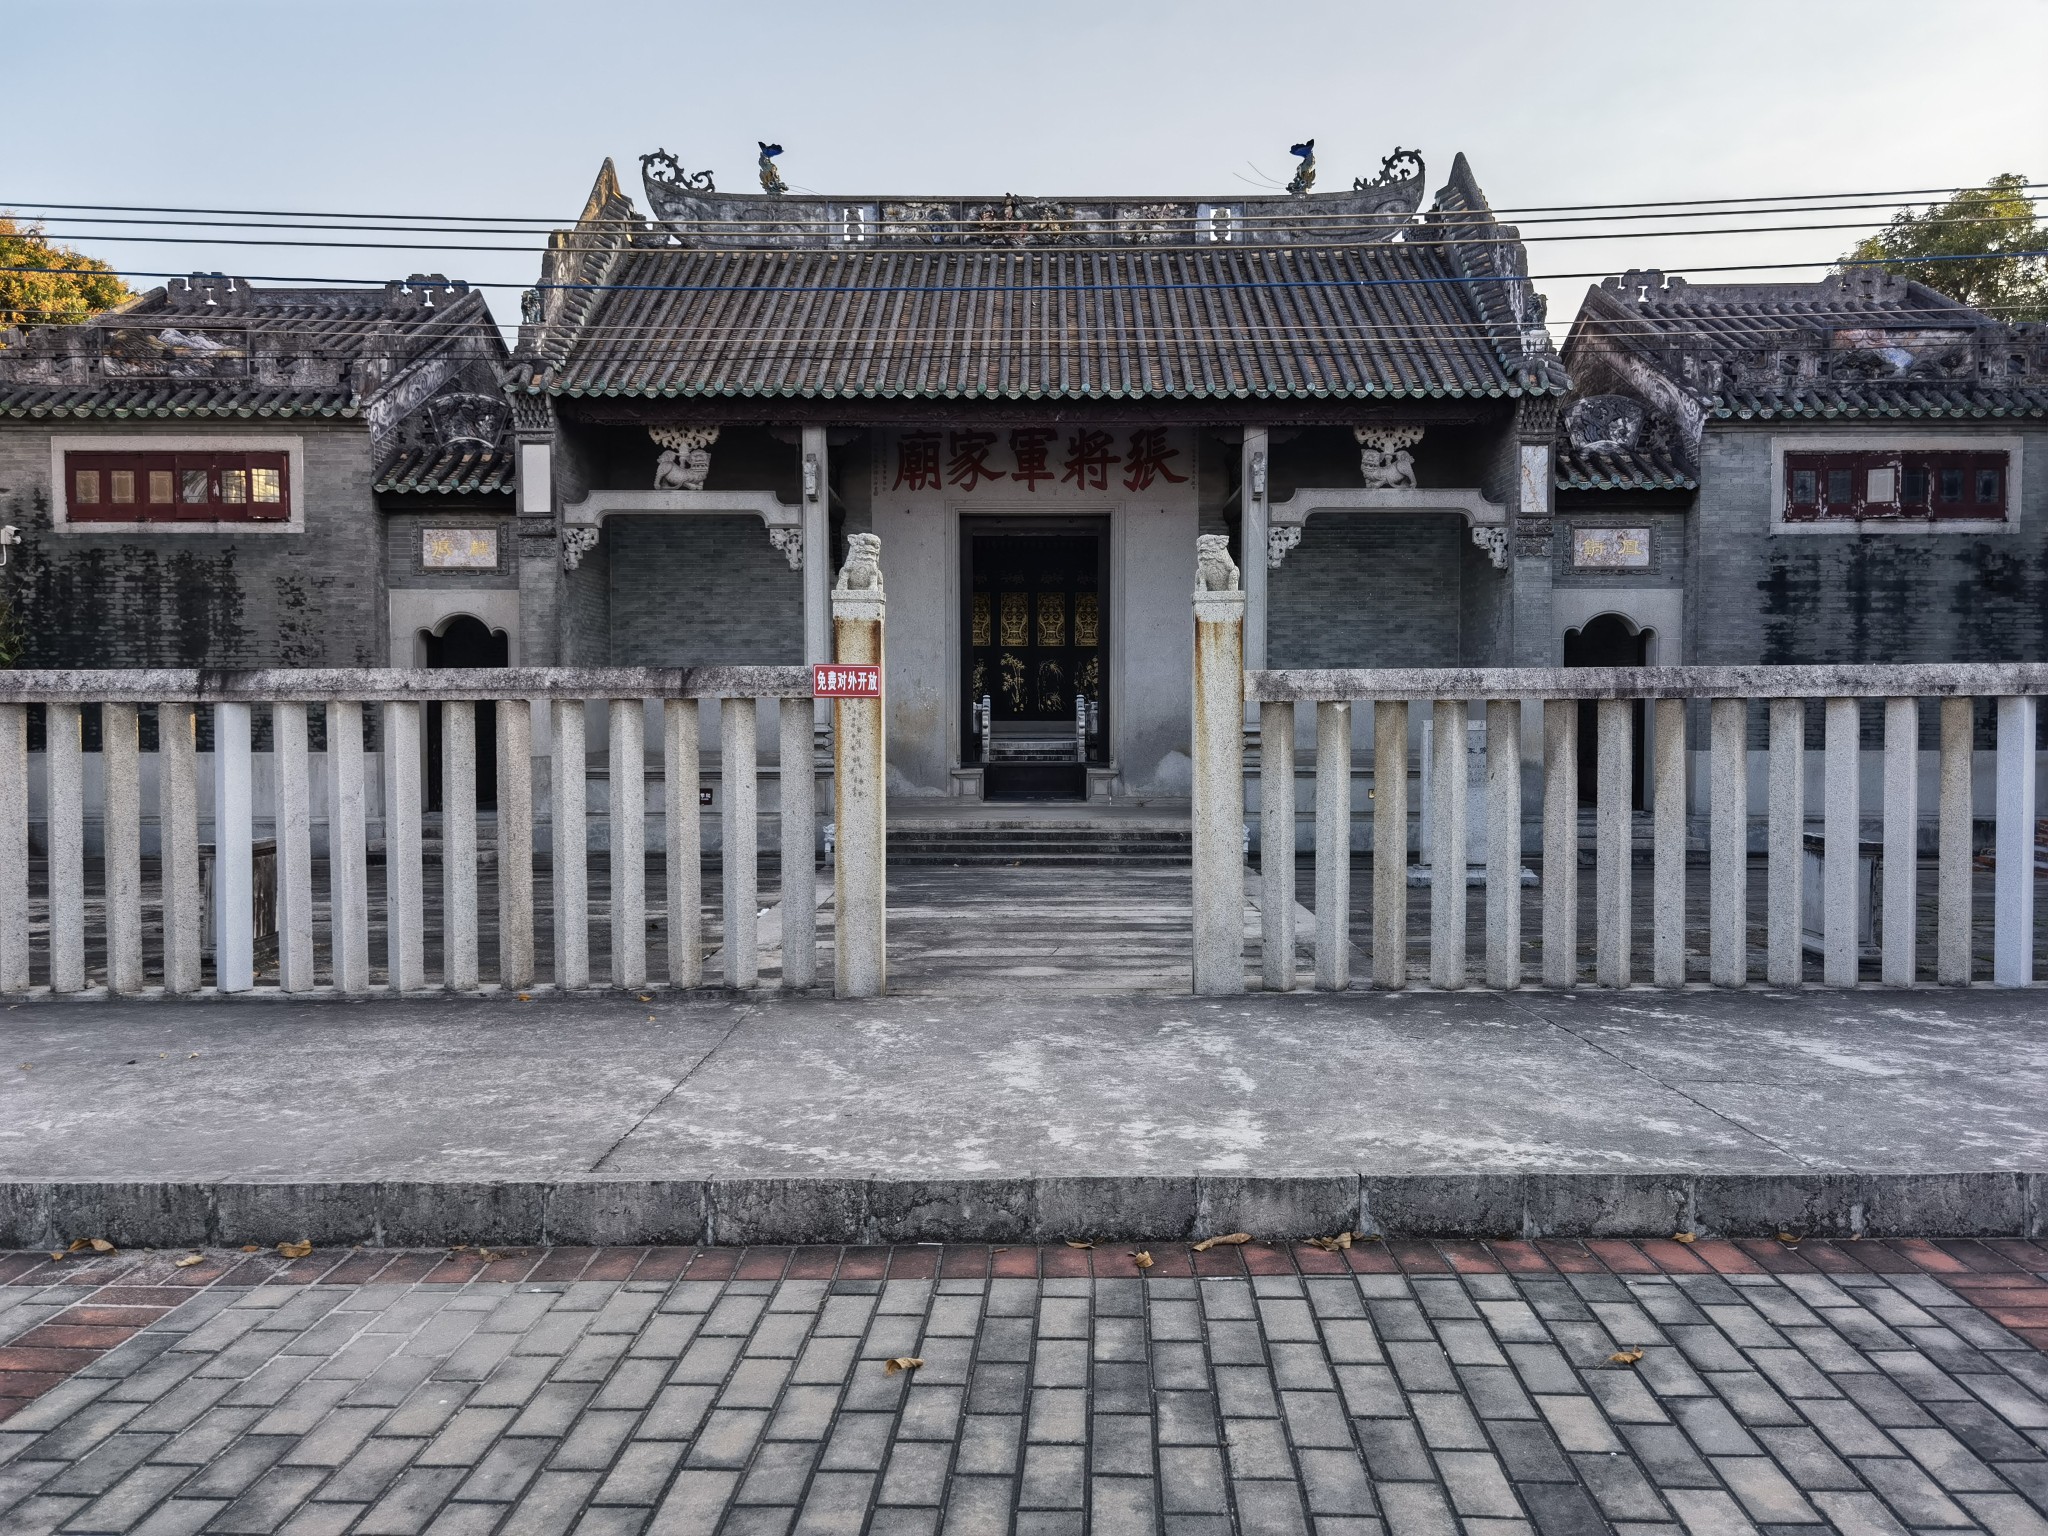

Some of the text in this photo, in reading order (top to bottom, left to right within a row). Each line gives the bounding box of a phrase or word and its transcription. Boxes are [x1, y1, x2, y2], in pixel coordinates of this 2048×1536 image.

[892, 427, 1189, 492] 張將軍家廟
[817, 671, 878, 691] 免费对外开放
